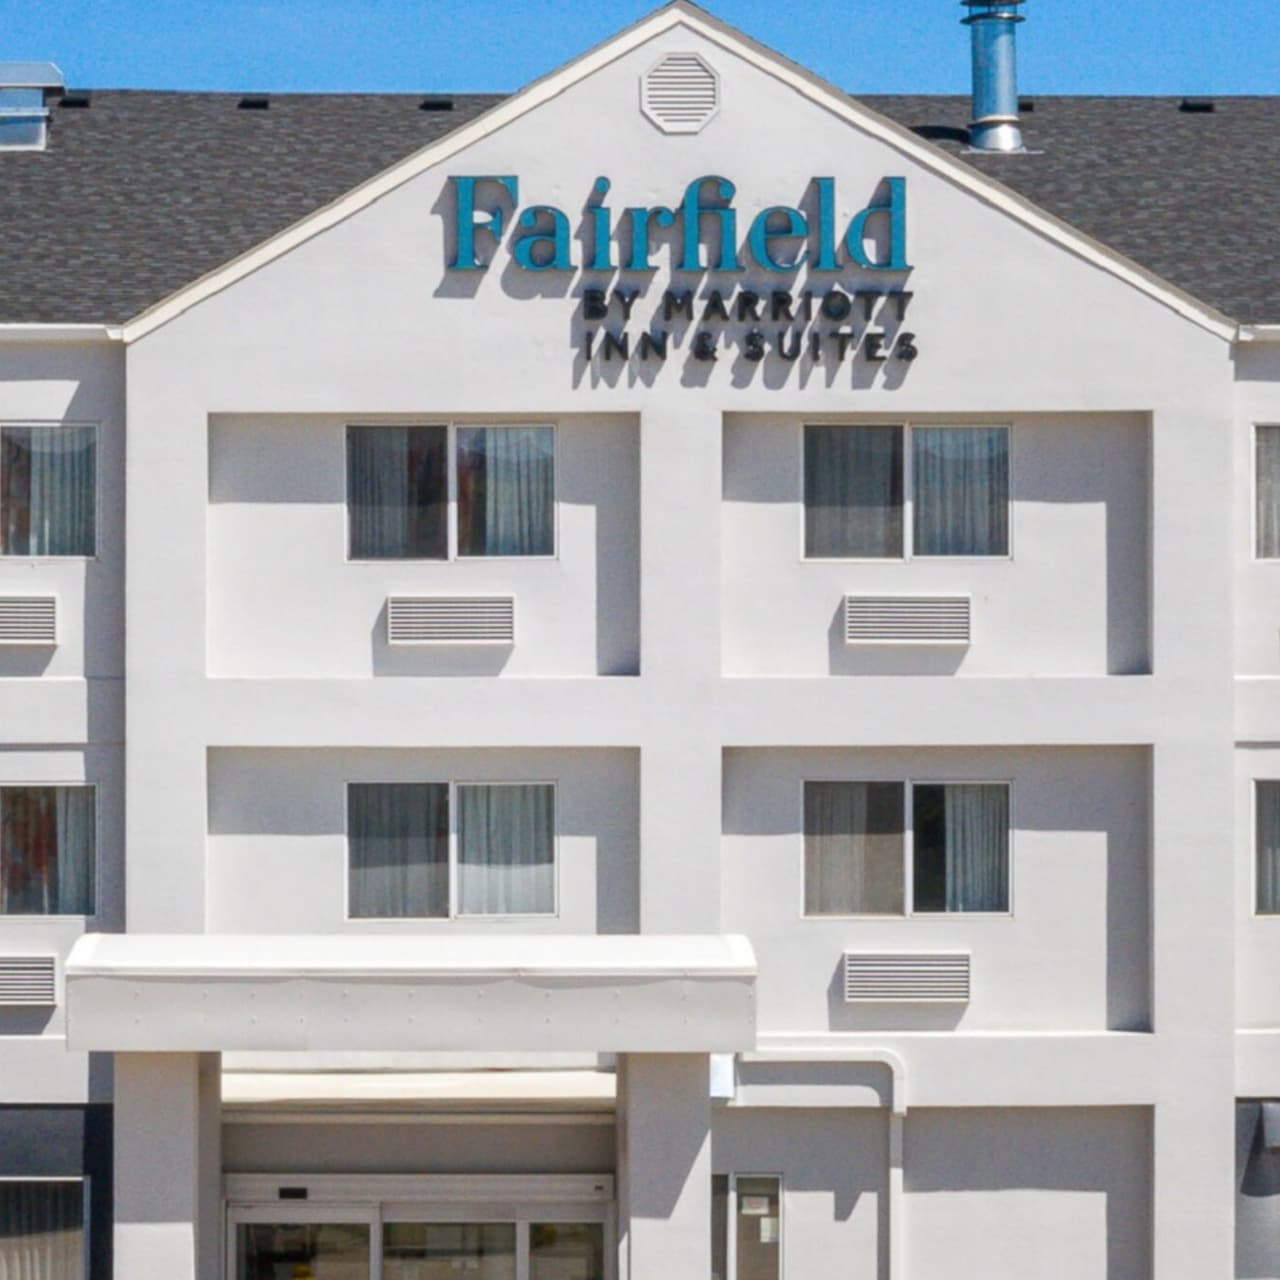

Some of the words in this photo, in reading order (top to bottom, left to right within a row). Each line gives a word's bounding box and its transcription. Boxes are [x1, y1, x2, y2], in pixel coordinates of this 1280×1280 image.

[447, 175, 914, 272] Fairfield
[583, 289, 641, 321] BY
[664, 290, 914, 322] MARRIOTT
[586, 331, 667, 361] INN
[693, 331, 718, 362] &
[743, 331, 918, 362] SUITES
